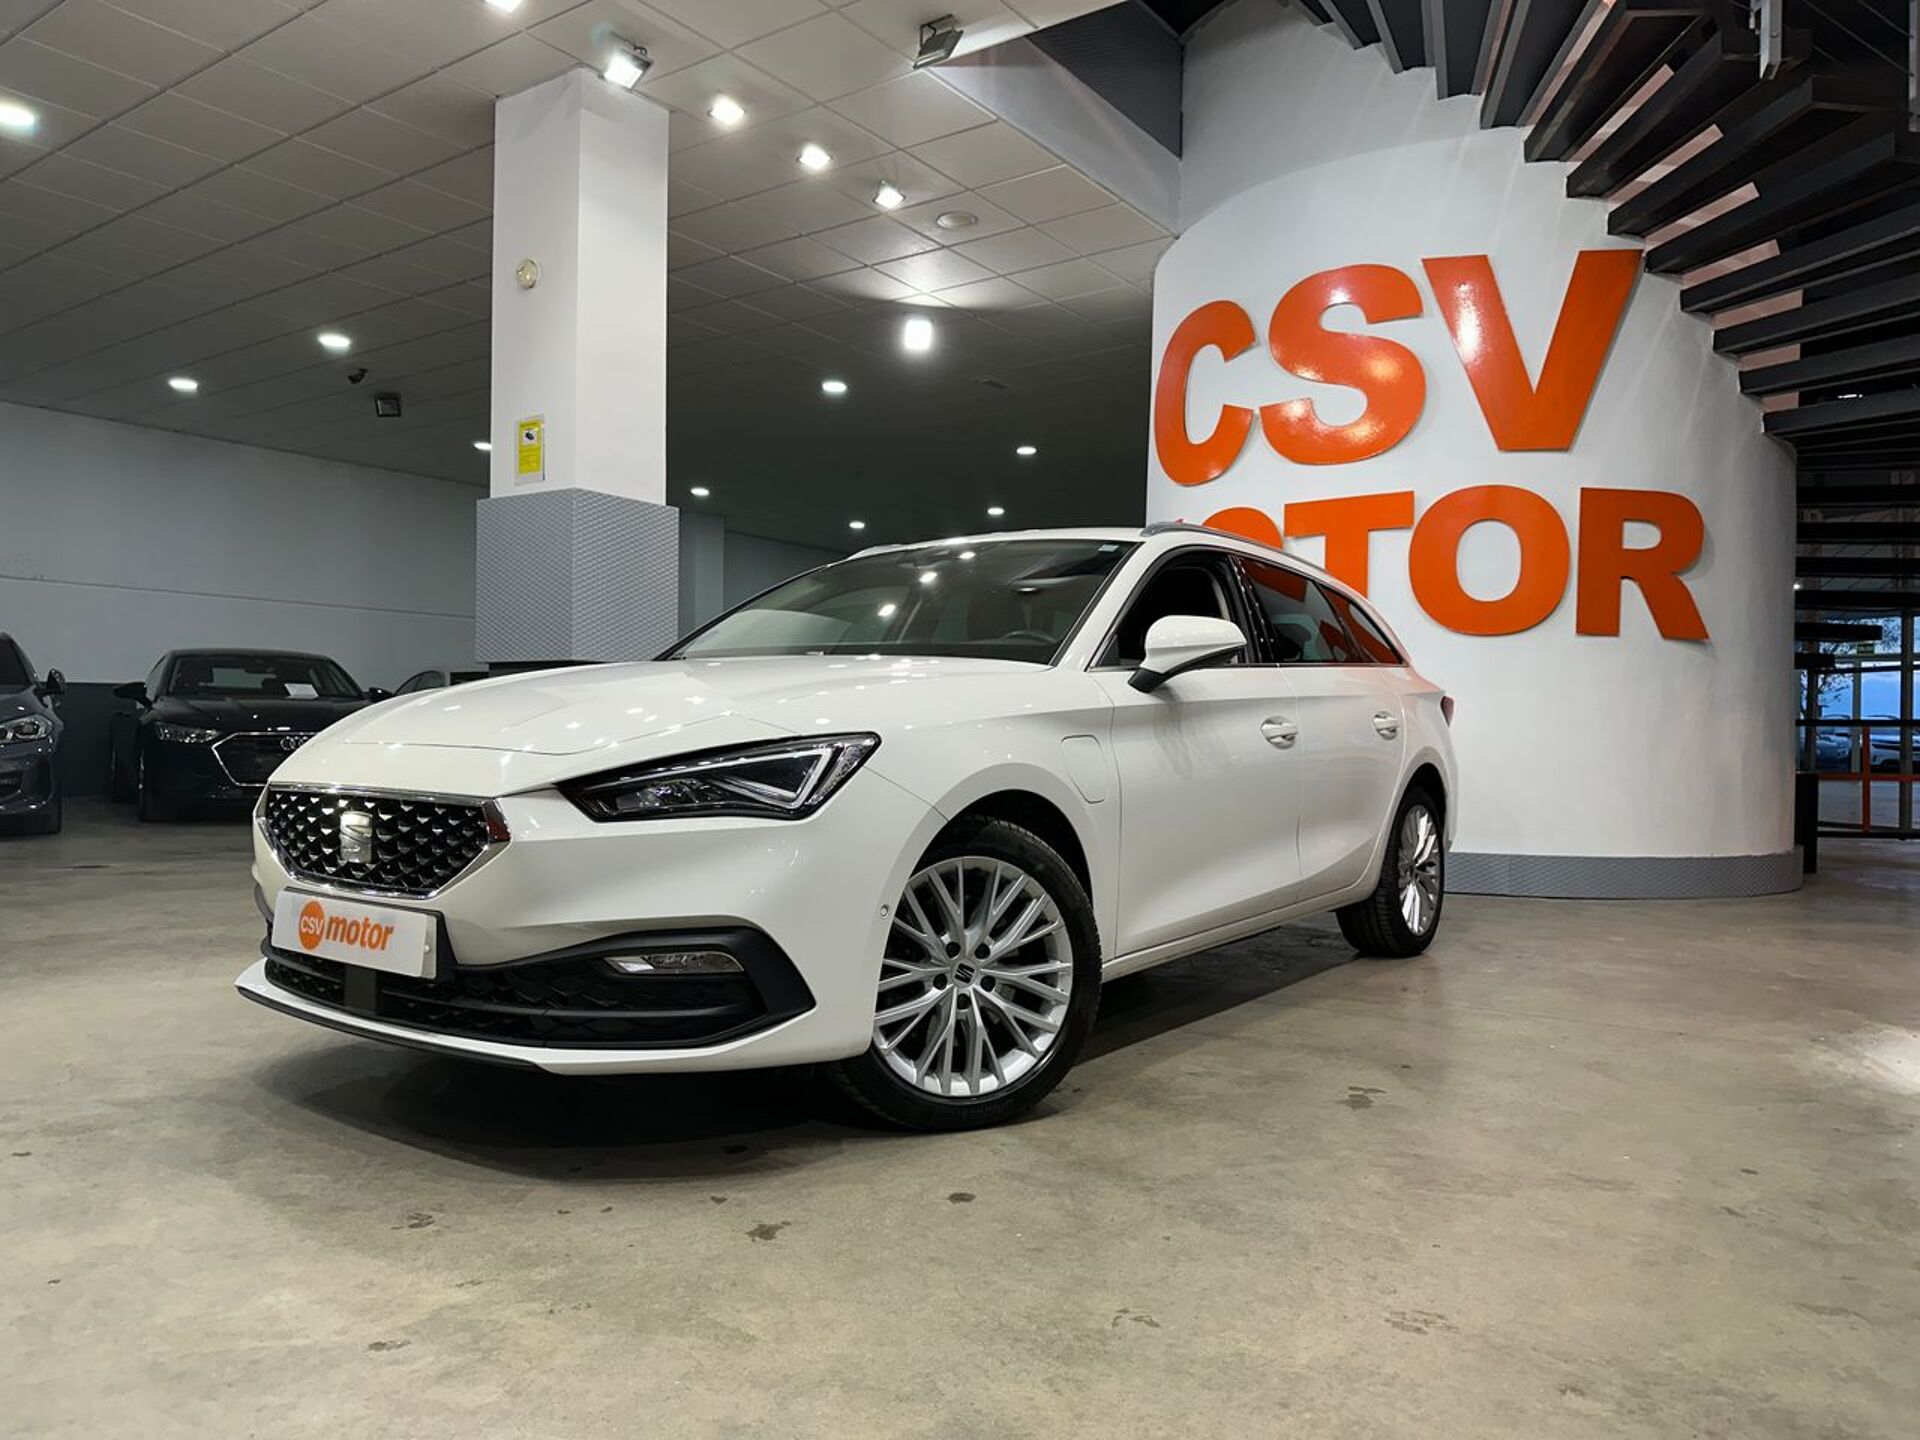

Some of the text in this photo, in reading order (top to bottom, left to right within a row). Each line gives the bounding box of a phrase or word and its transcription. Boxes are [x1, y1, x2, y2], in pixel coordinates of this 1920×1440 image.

[1154, 249, 1644, 487] CSV
[1176, 484, 1710, 641] TOR
[301, 915, 395, 950] CSV motor
